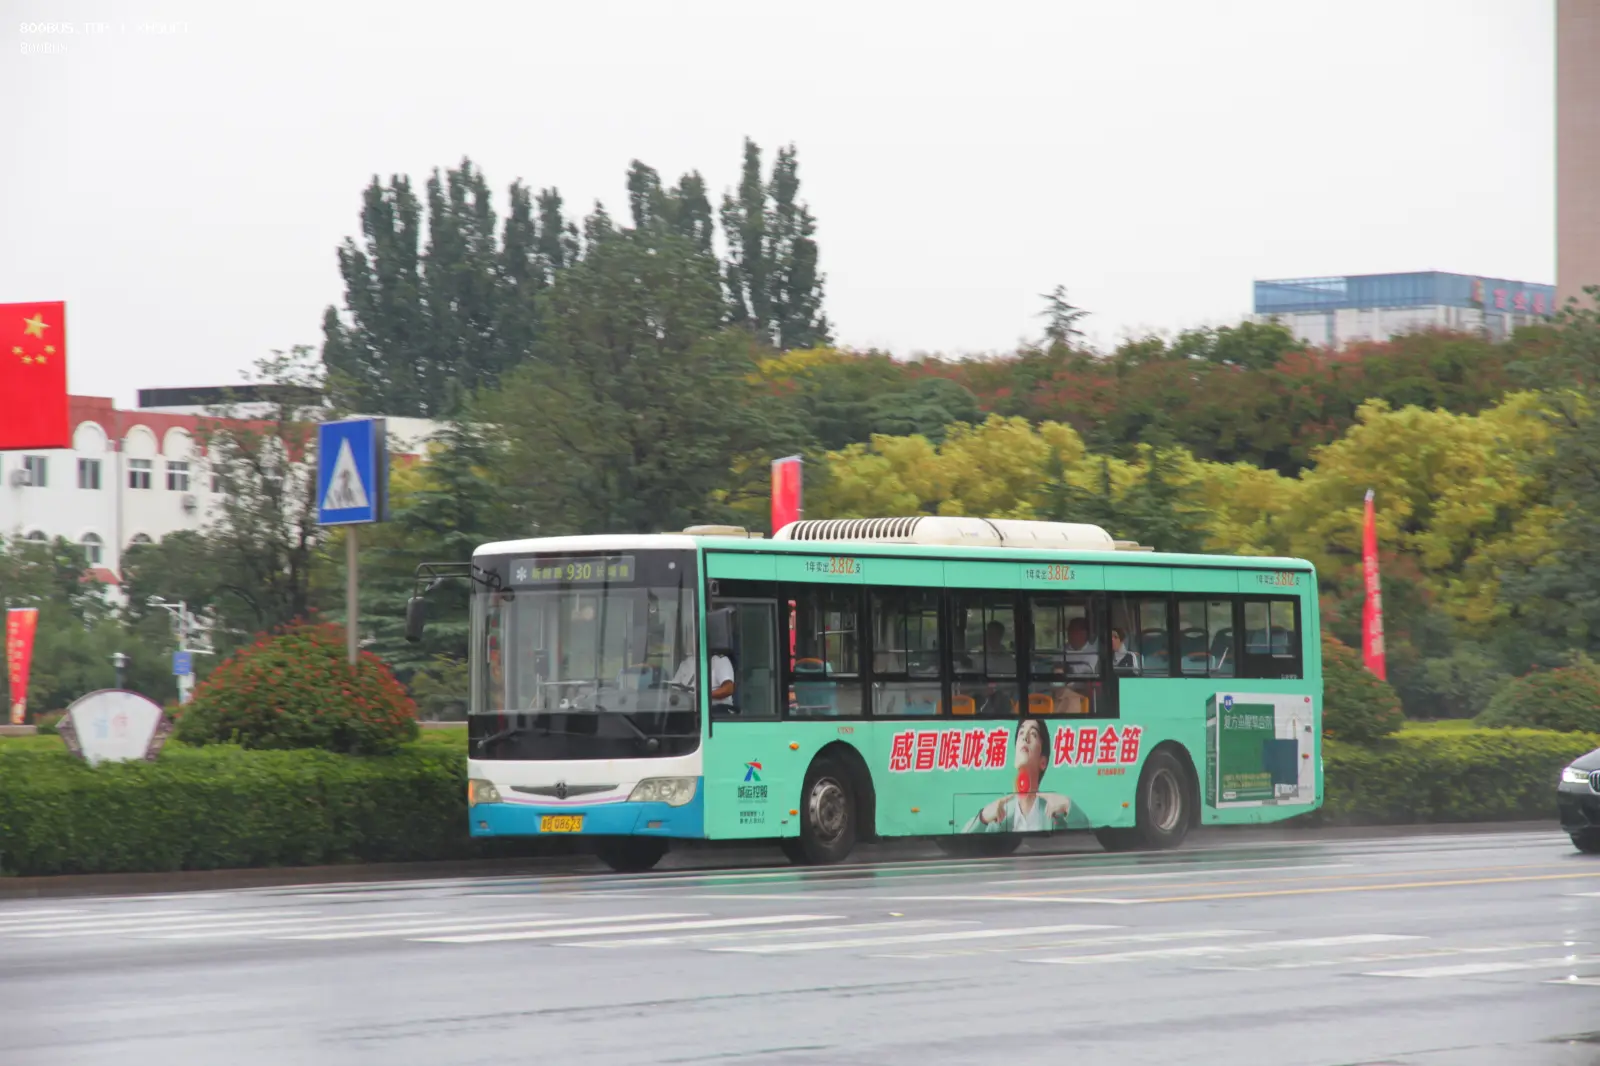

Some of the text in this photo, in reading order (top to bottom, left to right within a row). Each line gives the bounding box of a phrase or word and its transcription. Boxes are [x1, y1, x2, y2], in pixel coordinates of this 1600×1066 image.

[566, 563, 592, 580] 930
[889, 725, 1142, 772] 感冒喉咙痛 快用金笛
